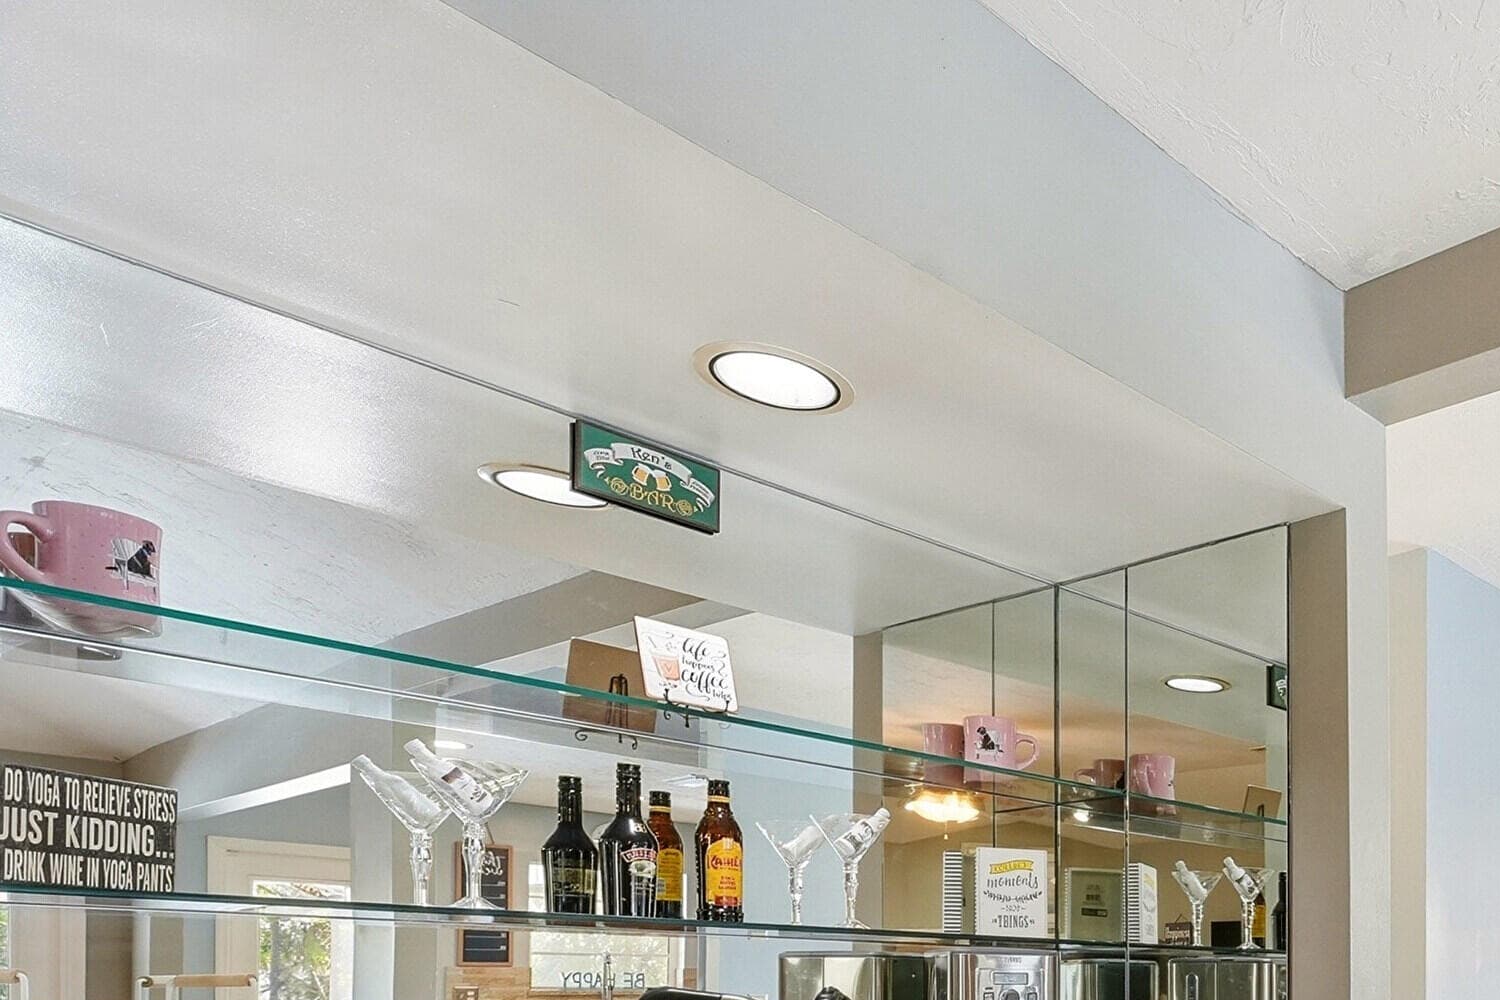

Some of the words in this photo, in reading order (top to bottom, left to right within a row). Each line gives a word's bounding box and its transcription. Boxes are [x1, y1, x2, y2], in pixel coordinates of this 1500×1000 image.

[631, 447, 672, 470] Ken's
[629, 482, 676, 513] BAR
[681, 669, 729, 694] coffee
[4, 767, 22, 802] DO
[26, 770, 61, 808] YOGA
[64, 777, 80, 811] TO
[83, 779, 131, 818] RELIEVE
[133, 788, 176, 823] STRESS
[0, 806, 59, 846] JUST
[65, 814, 175, 860] KIDDING...
[3, 848, 46, 883] DRINK
[49, 853, 84, 886] WINE
[87, 856, 100, 888] IN
[103, 859, 134, 891] YOGA
[136, 862, 173, 893] PANTS
